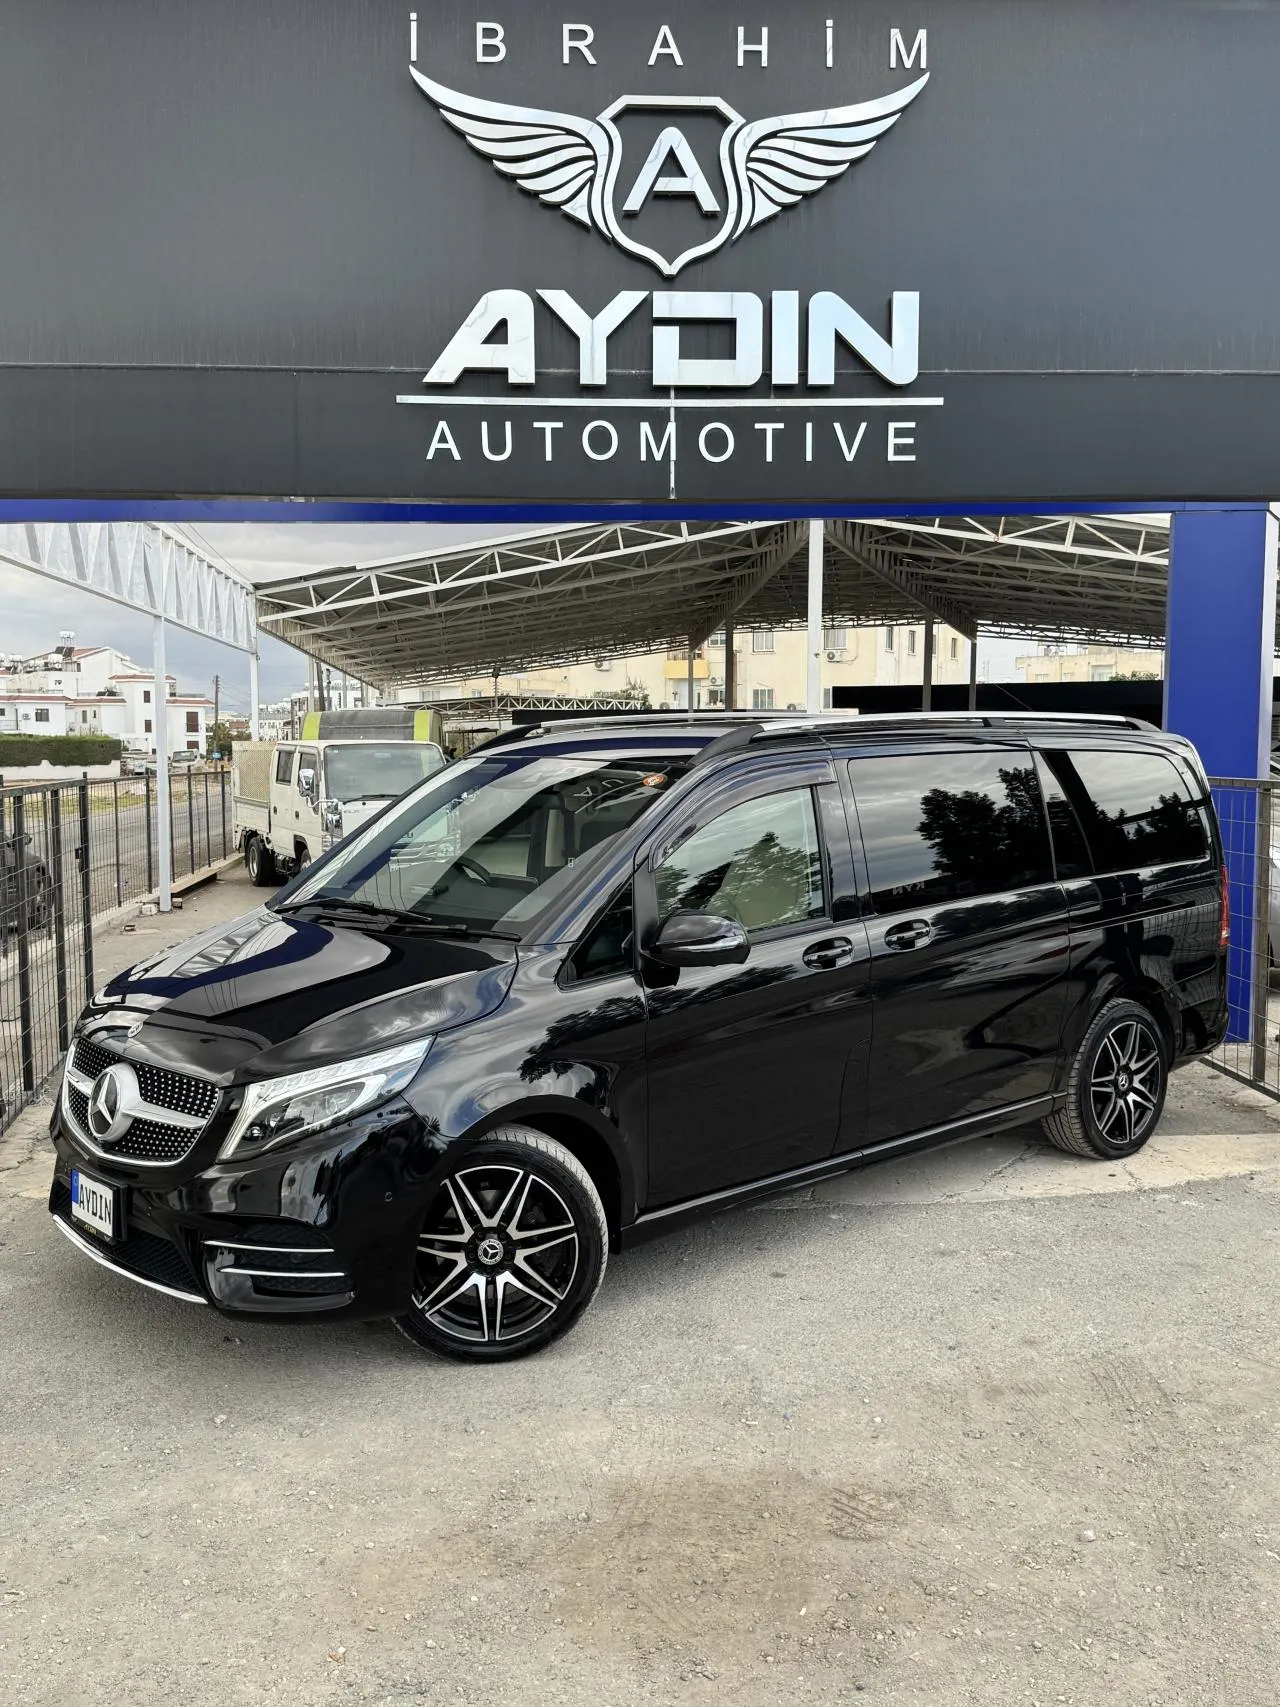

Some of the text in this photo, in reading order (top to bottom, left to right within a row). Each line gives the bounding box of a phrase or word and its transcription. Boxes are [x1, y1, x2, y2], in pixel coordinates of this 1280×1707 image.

[409, 12, 928, 69] İBRAHİM
[622, 126, 721, 214] A
[422, 288, 920, 387] AYDIN
[426, 419, 916, 463] AUTOMOTIVE
[79, 1183, 112, 1225] AYDIN
